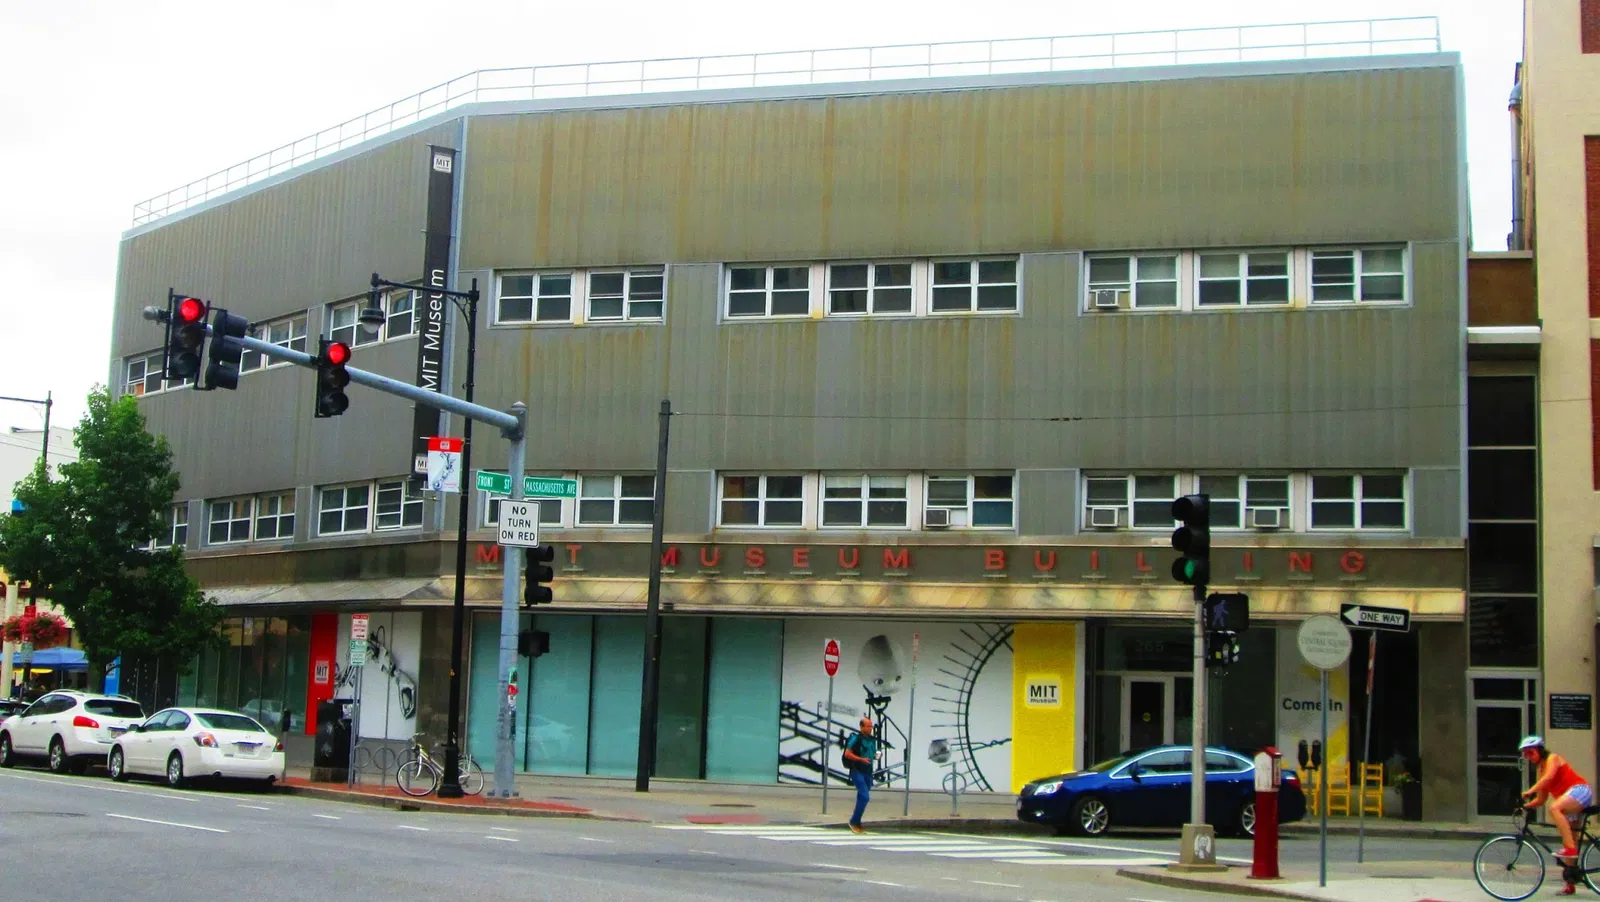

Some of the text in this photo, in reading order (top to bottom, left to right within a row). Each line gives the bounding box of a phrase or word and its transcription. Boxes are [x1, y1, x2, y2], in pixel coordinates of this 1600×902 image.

[436, 158, 450, 167] MIT
[421, 356, 438, 391] MIT
[418, 460, 427, 468] MI
[478, 476, 510, 490] FRONT ST
[526, 481, 576, 495] MASSACHUSETTS AVE
[512, 506, 527, 516] NO
[508, 518, 531, 529] TURN
[501, 530, 535, 541] ON RED
[474, 544, 582, 564] MT
[985, 549, 1365, 574] BUILING
[1360, 612, 1402, 624] ONE WAY
[316, 666, 328, 676] MIT
[1030, 684, 1057, 698] MIT
[1282, 697, 1343, 711] Come In
